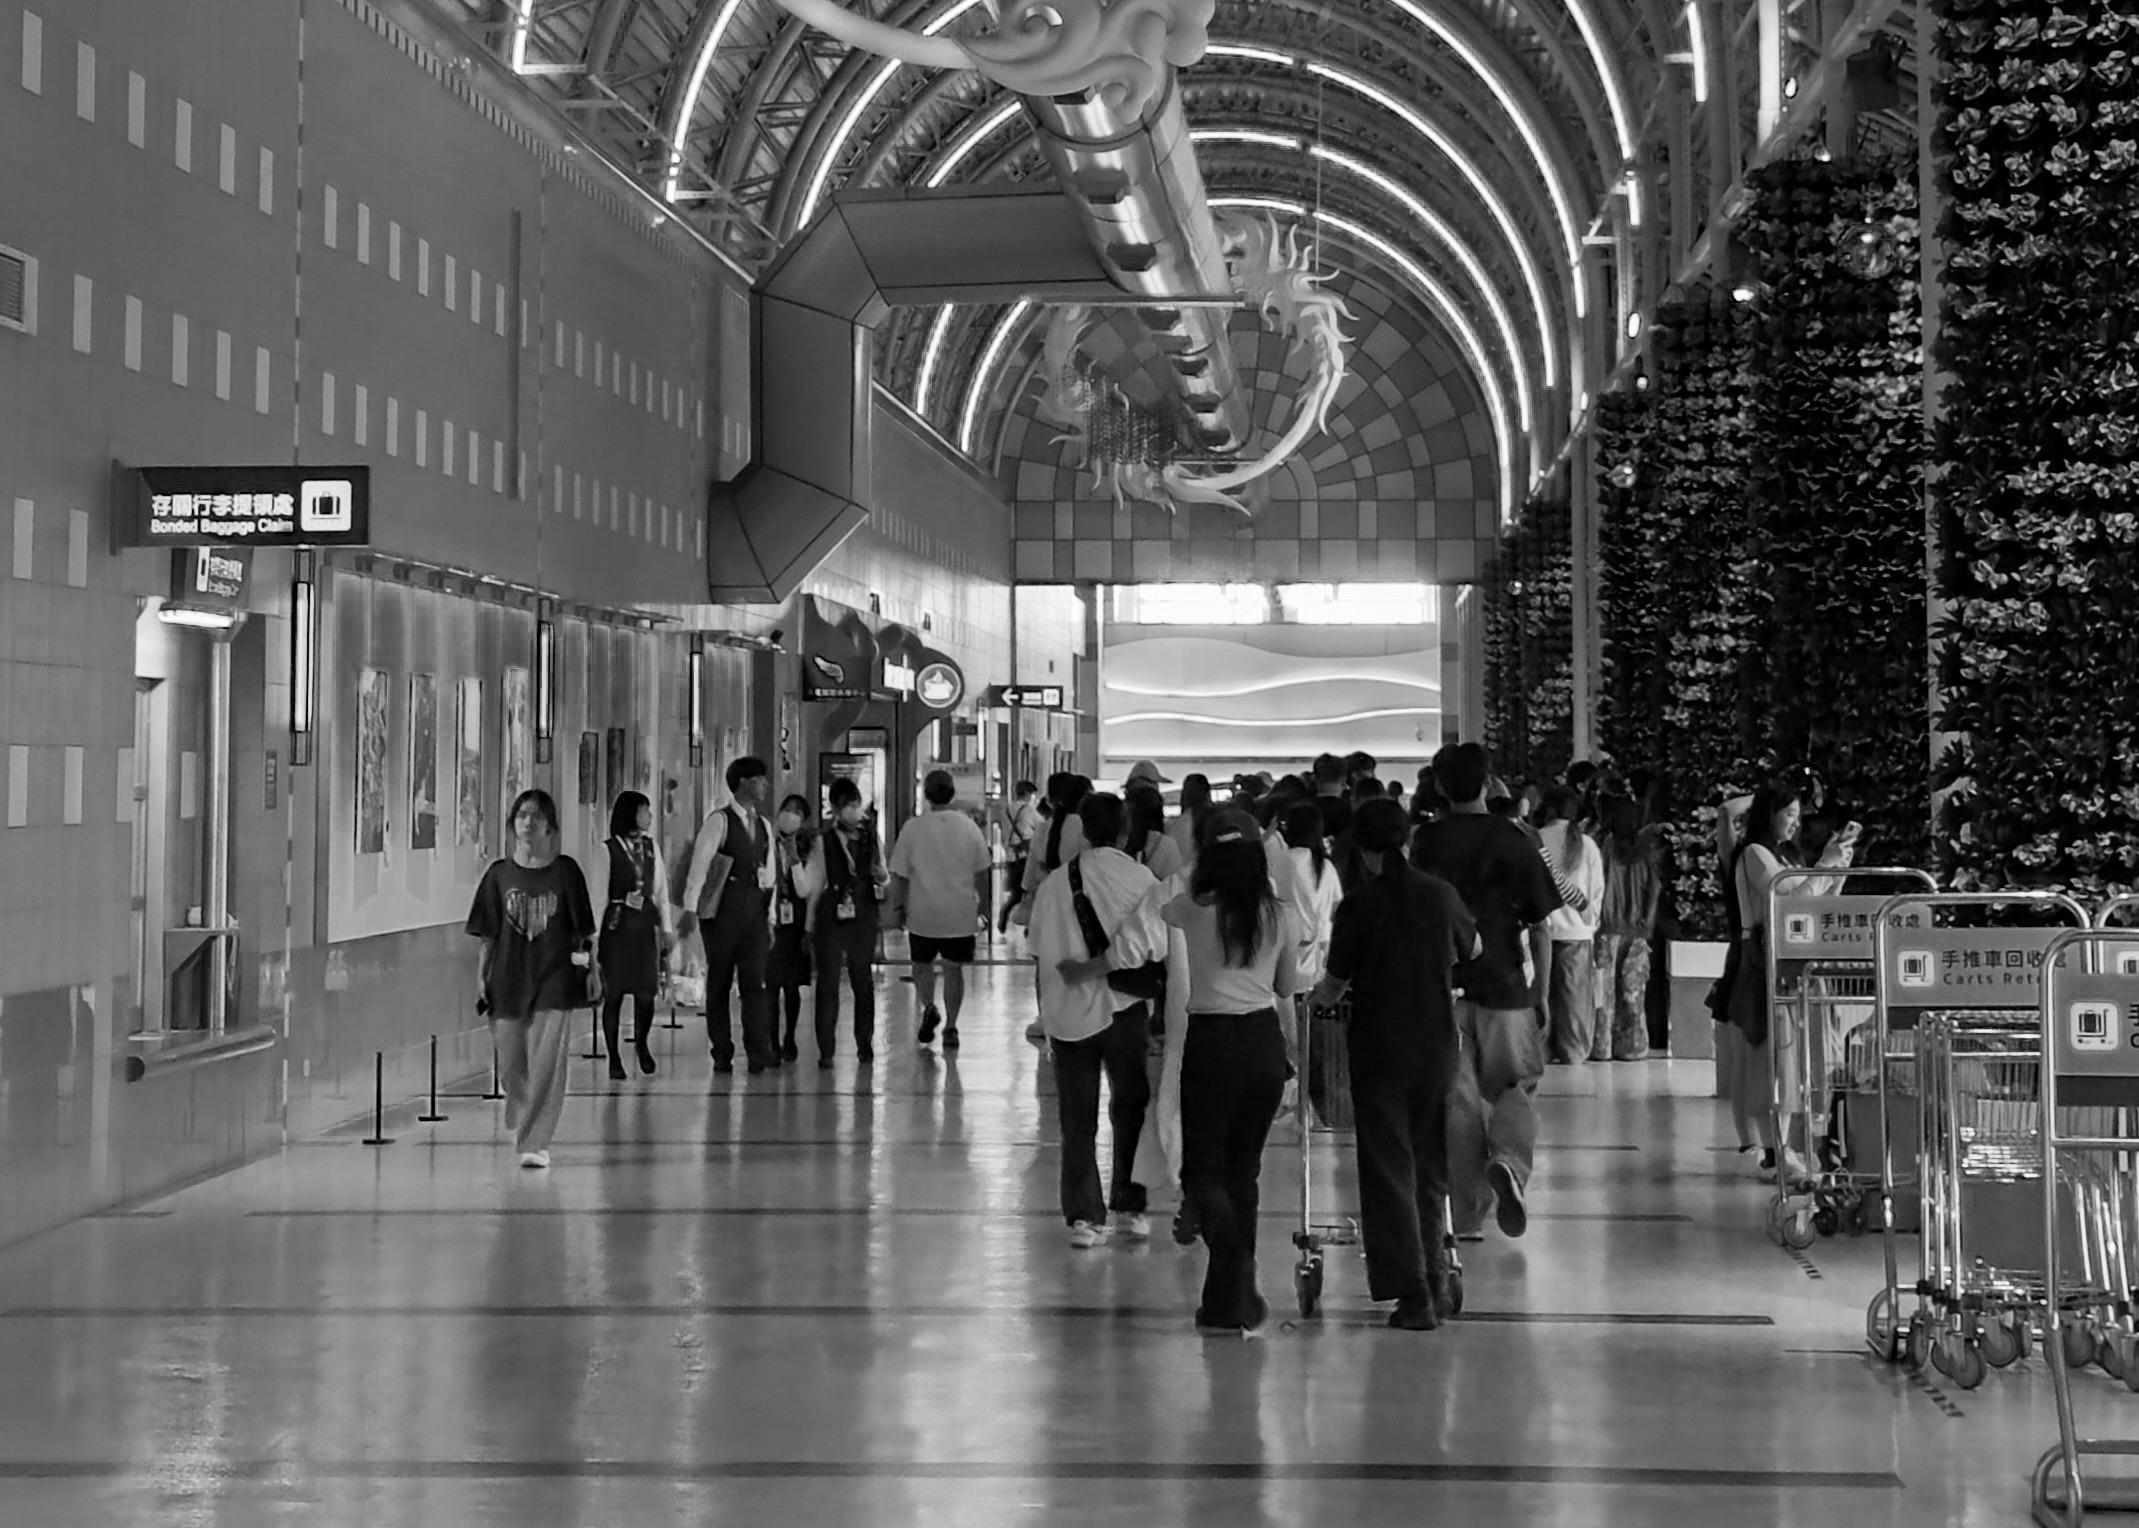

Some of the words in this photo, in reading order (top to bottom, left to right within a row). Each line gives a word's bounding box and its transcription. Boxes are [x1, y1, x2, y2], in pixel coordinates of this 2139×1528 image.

[151, 519, 198, 533] Bonded
[200, 518, 255, 536] Baggage
[258, 518, 294, 532] Claim
[1821, 932, 1861, 942] Carts
[1943, 973, 1993, 985] Carts
